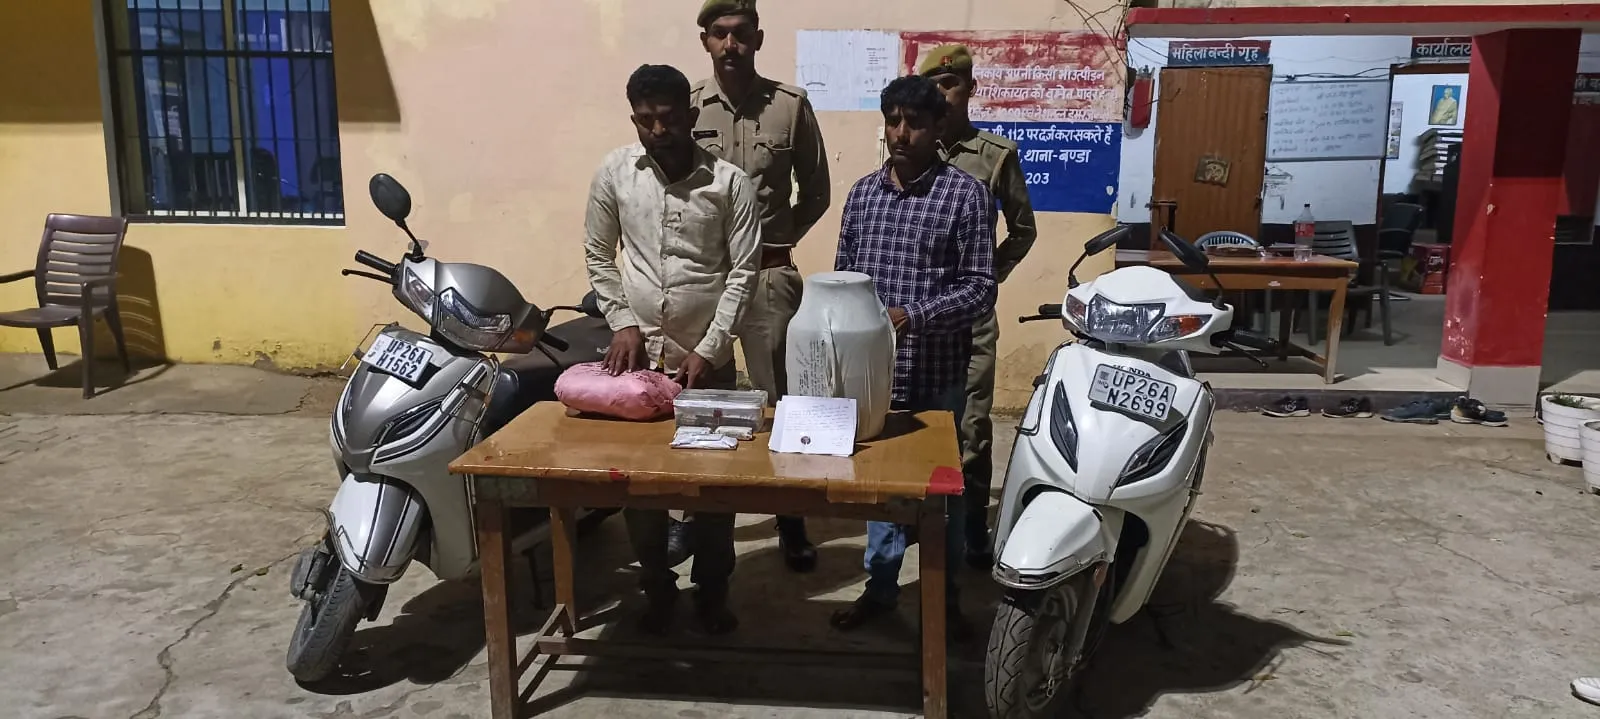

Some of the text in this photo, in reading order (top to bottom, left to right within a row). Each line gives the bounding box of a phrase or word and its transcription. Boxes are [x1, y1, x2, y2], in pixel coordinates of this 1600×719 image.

[989, 84, 1028, 99] शिकायत
[1025, 172, 1049, 185] 203
[376, 351, 418, 378] H1562
[387, 339, 426, 365] UP26A
[1112, 371, 1169, 402] UP26A
[1107, 388, 1166, 417] N2699
